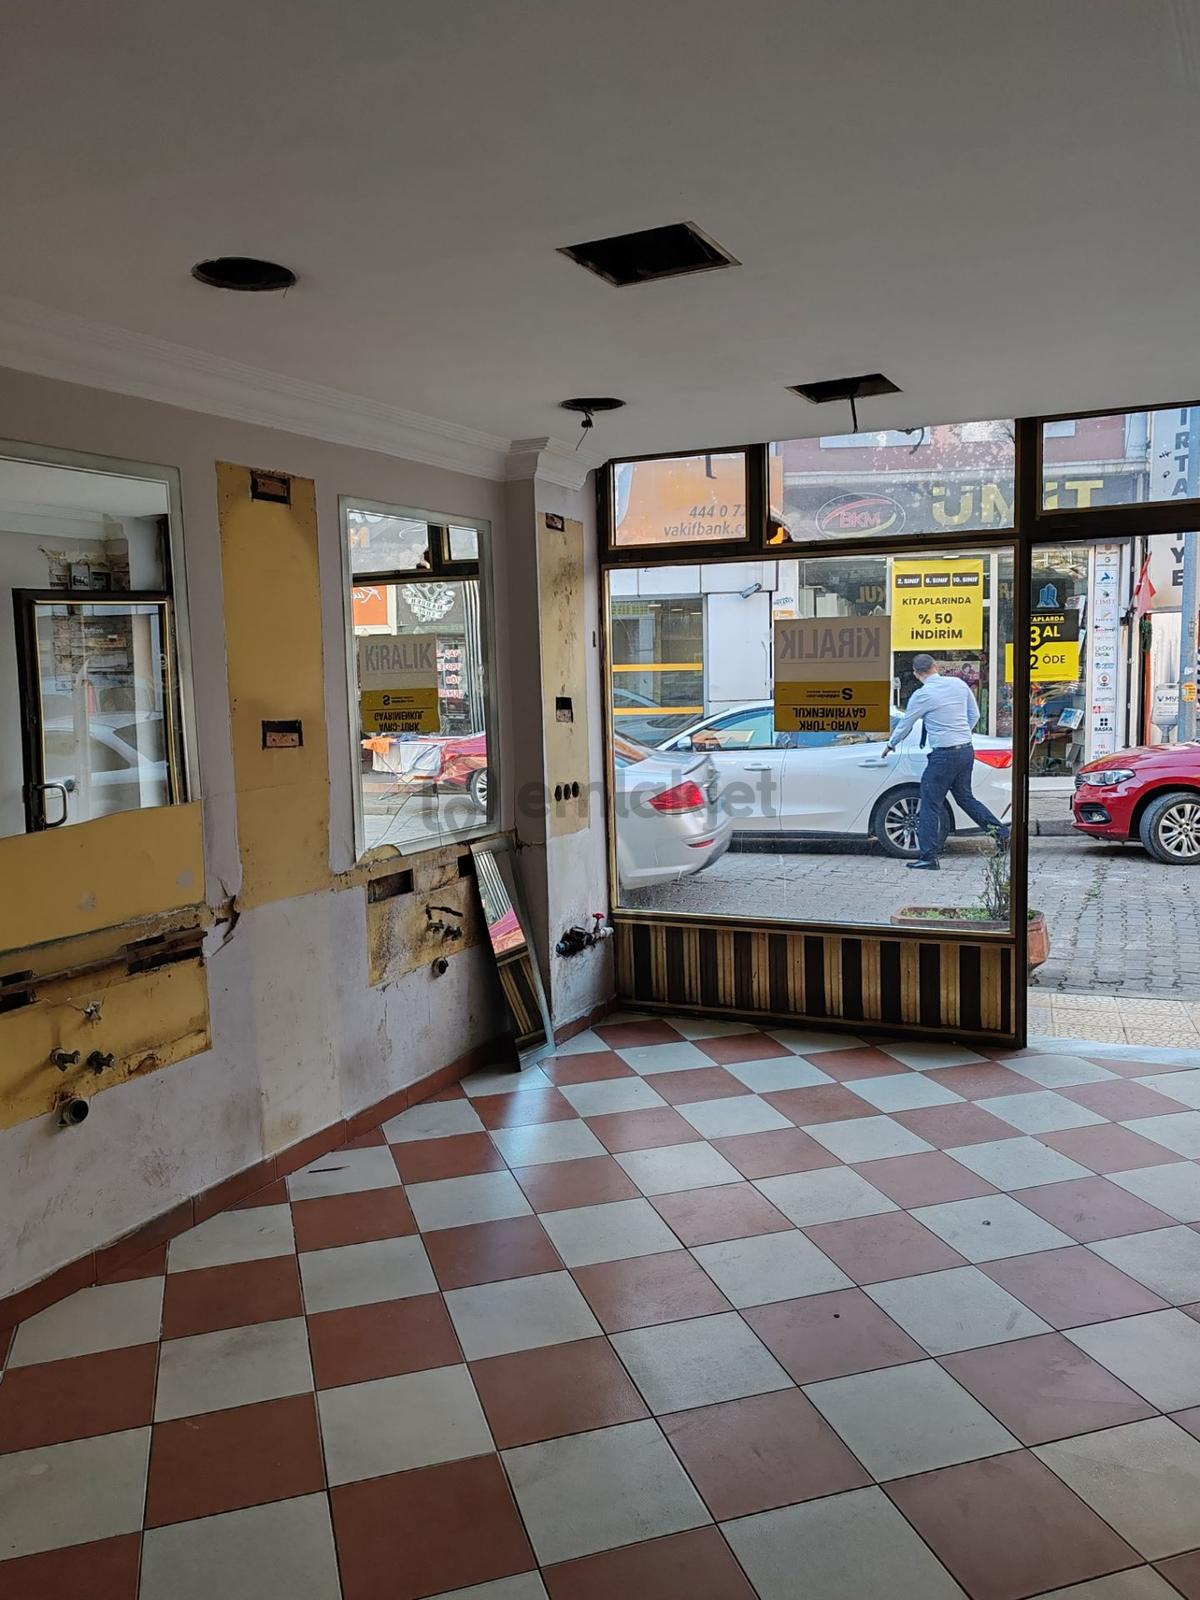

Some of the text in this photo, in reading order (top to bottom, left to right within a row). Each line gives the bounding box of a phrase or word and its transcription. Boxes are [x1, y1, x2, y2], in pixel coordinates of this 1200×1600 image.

[689, 504, 715, 518] 444
[720, 504, 728, 517] 0
[839, 511, 881, 528] BKM
[902, 596, 971, 605] KİTAPLARINDA
[918, 613, 952, 624] % 50
[911, 627, 963, 640] İNDİRİM
[1030, 625, 1061, 647] 3 AL
[1030, 653, 1066, 669] 2 ÖDE
[792, 707, 866, 718] GAYRİMENKUL
[800, 720, 859, 732] AVRO-TÜRK
